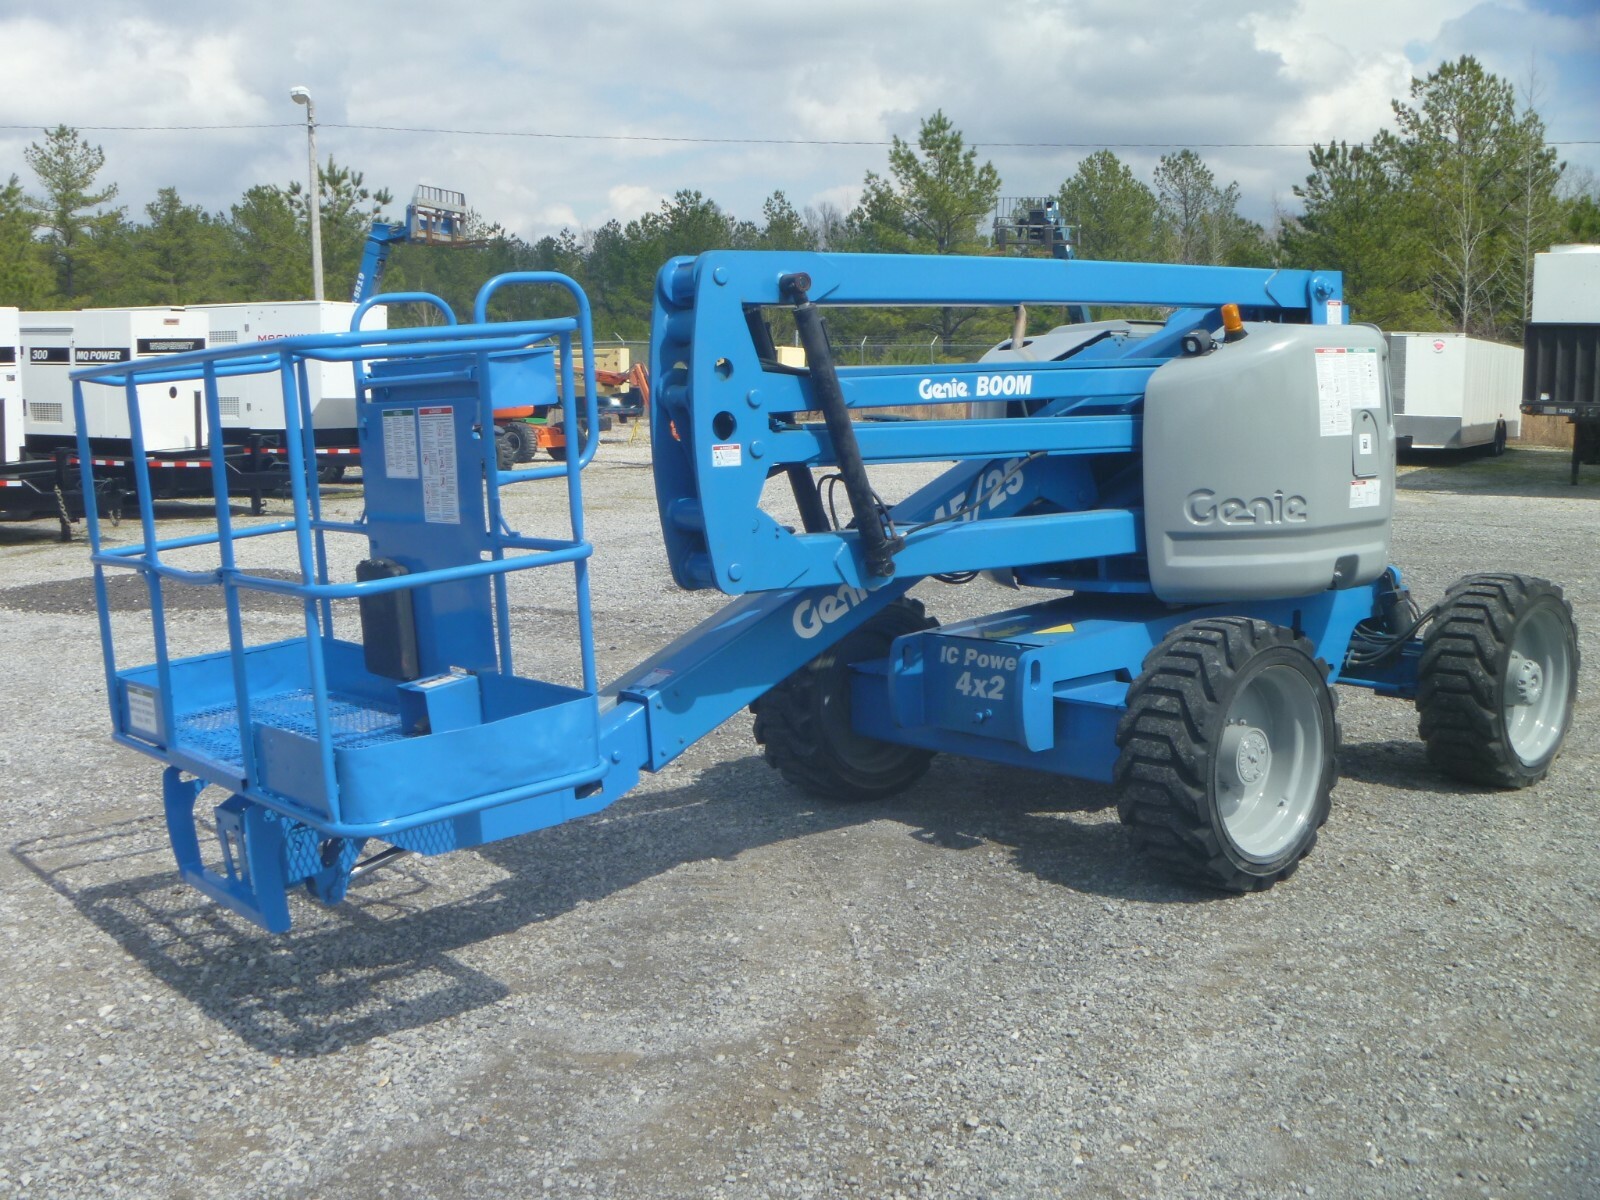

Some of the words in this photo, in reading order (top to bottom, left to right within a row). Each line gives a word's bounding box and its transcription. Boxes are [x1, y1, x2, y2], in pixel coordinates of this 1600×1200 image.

[32, 349, 48, 360] 300
[76, 350, 88, 360] MQ
[89, 350, 121, 360] POWER
[918, 377, 968, 400] Genie
[976, 375, 1032, 396] BOOM
[1183, 488, 1307, 526] Genie
[792, 583, 882, 639] Gen
[940, 645, 960, 665] IC
[963, 647, 1018, 671] Powe
[955, 671, 1006, 701] 4x2
